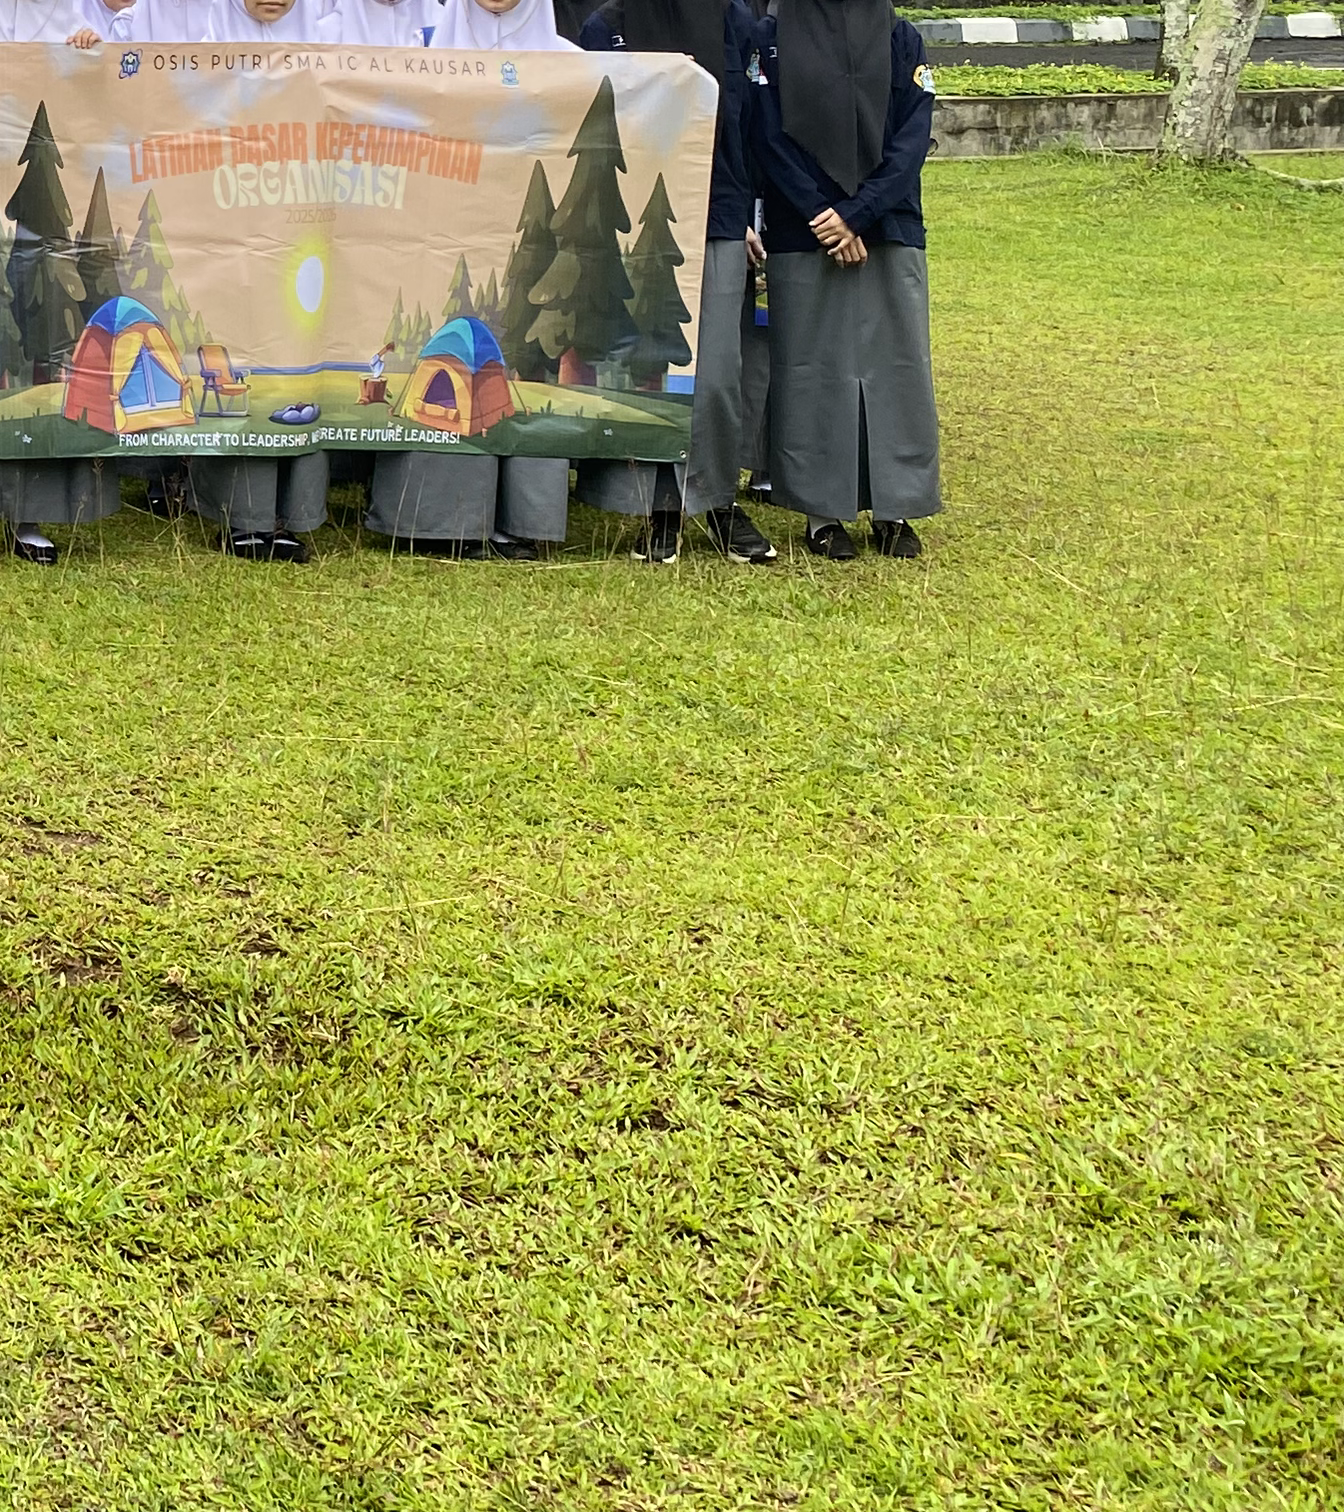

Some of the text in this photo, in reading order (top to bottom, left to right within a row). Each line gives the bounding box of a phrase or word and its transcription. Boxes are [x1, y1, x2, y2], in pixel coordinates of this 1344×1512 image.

[153, 54, 487, 76] OSIS PUTRI SMA IC AL KAUSAR
[129, 122, 483, 185] LATIHAN DASAR KEPEMIMPINAN
[212, 159, 408, 210] ORGANISASI
[119, 433, 148, 447] FROM
[151, 433, 221, 447] CHARACTER
[225, 434, 239, 446] TO
[360, 428, 402, 443] FUTURE
[404, 428, 461, 444] LEADERS!
